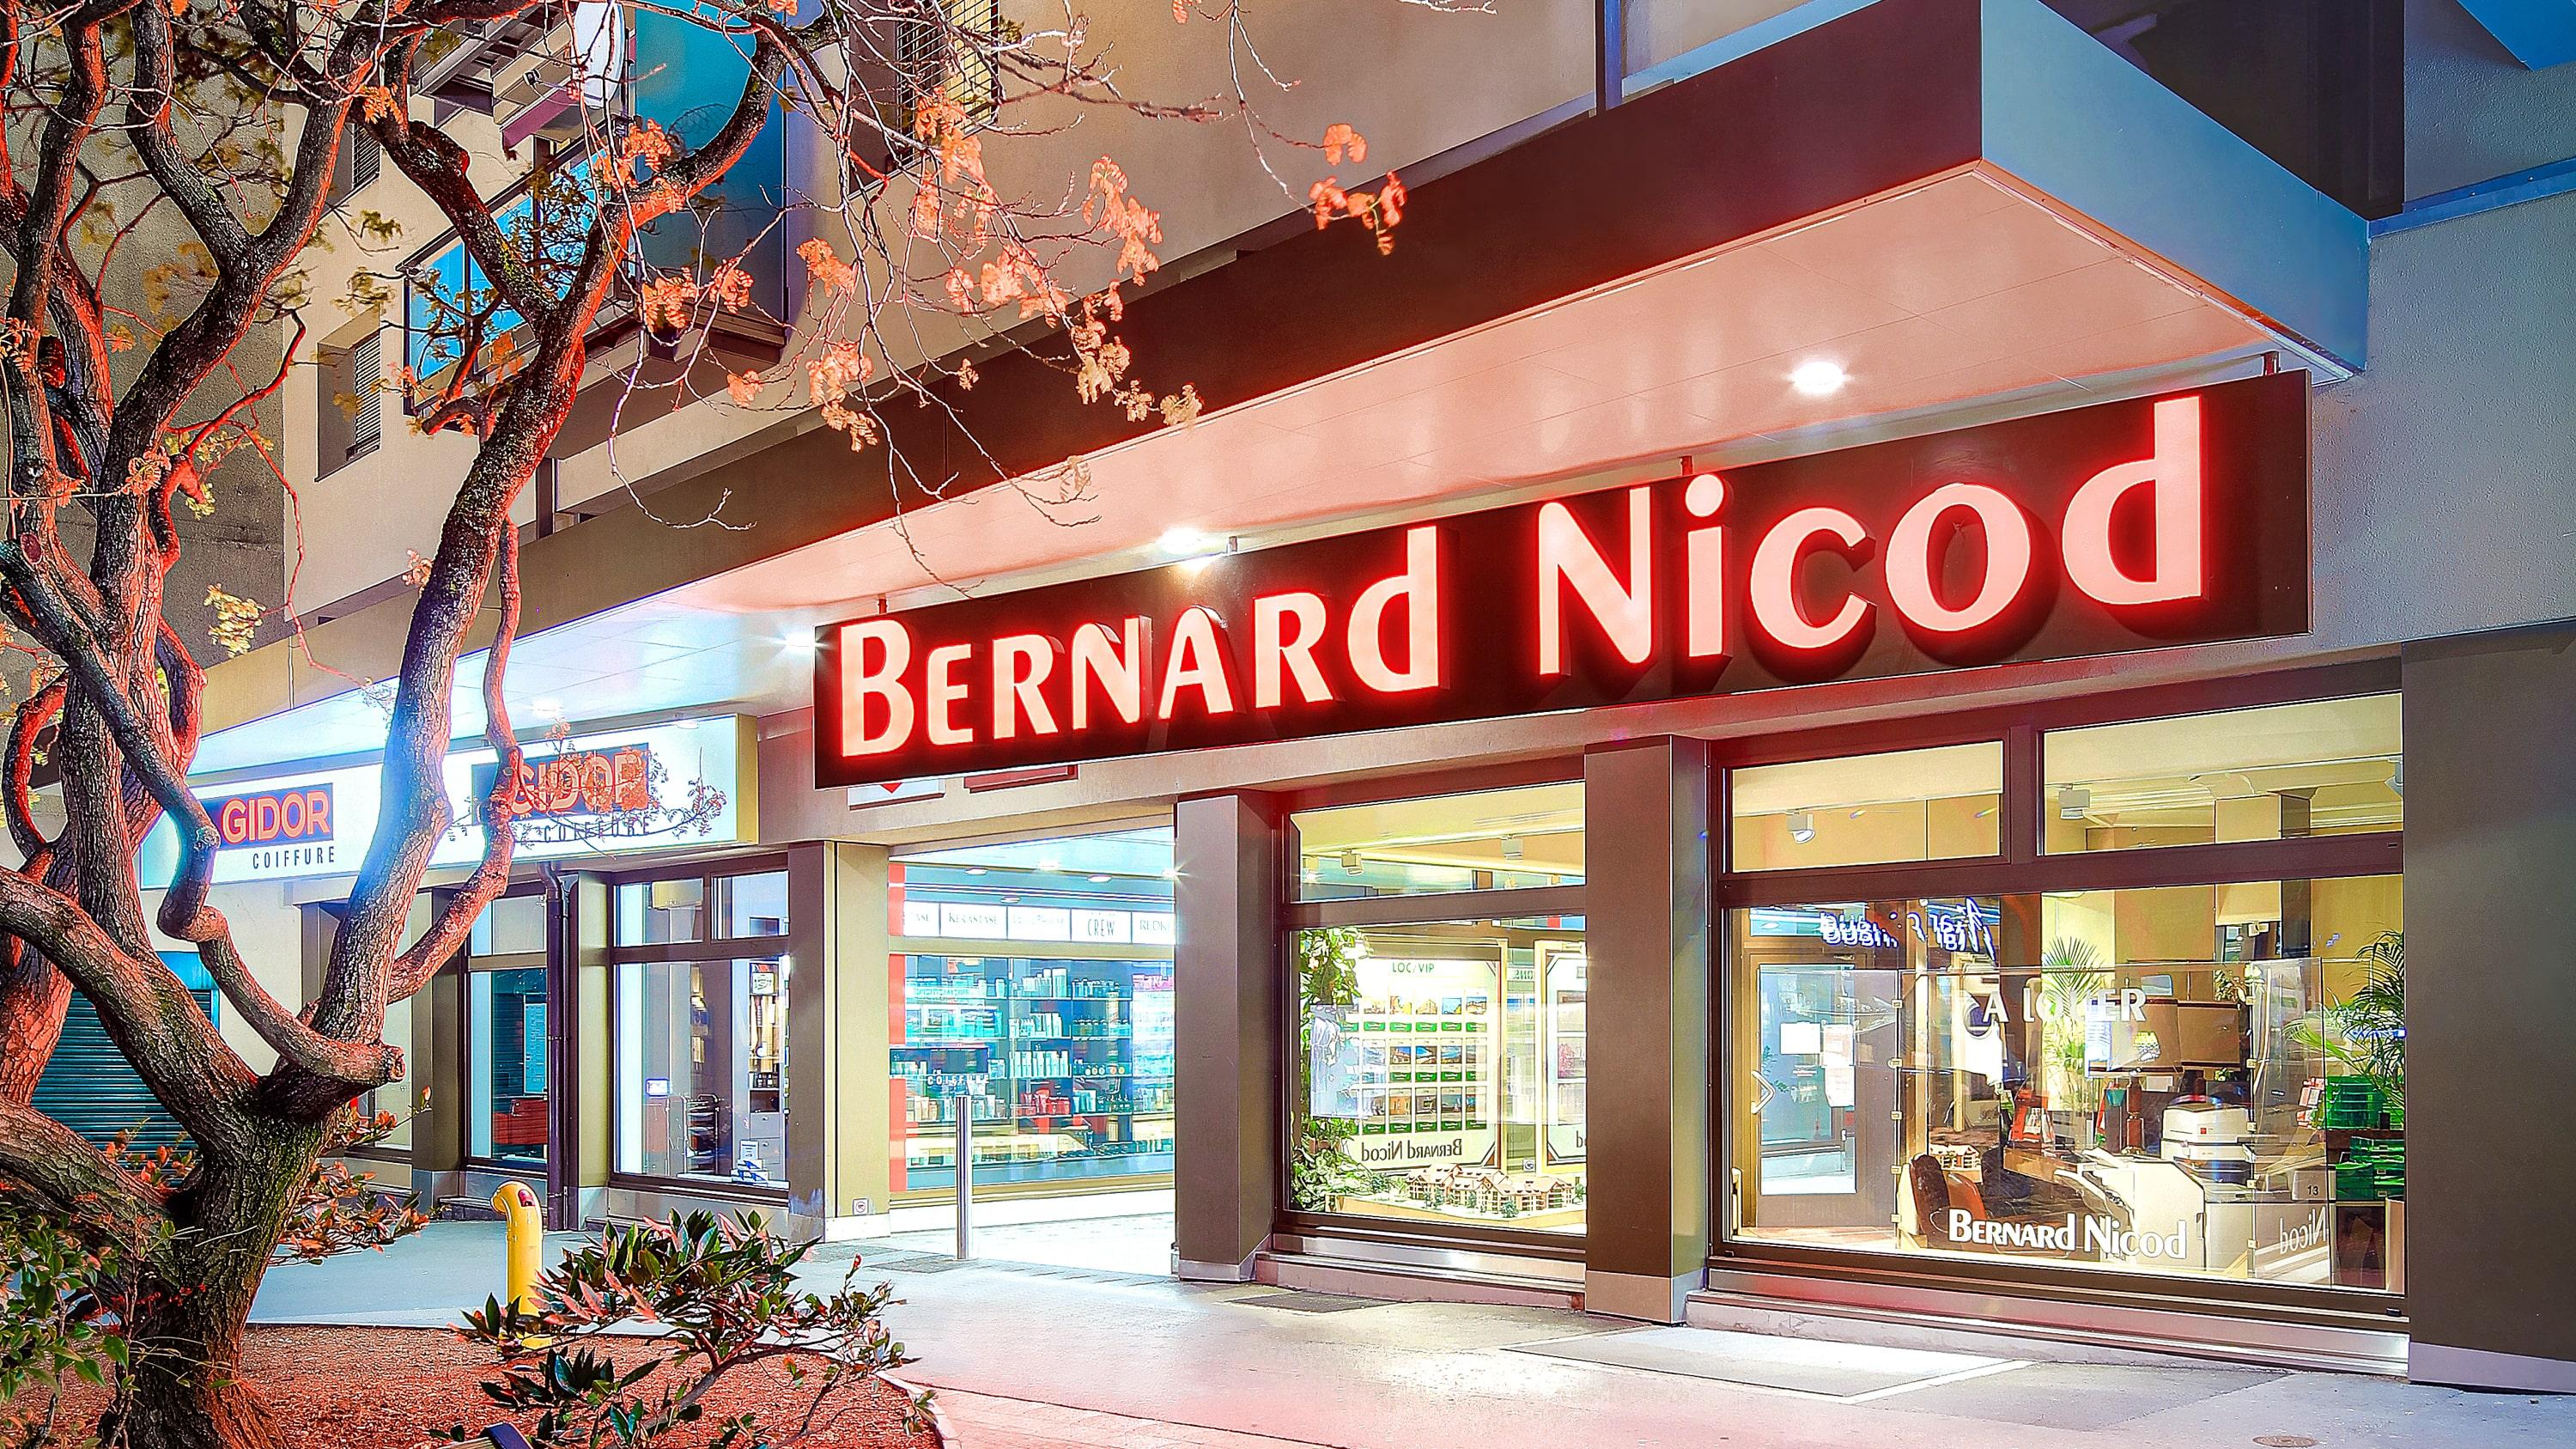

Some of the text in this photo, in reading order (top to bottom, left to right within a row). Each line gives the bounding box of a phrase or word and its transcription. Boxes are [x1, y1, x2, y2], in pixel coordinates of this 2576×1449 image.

[1537, 395, 2203, 680] Nicod
[222, 789, 331, 844] GIDOR
[252, 846, 335, 869] COIFFURE
[1087, 918, 1116, 937] CREW
[2307, 1184, 2319, 1196] 13
[2083, 1213, 2188, 1260] Nicod
